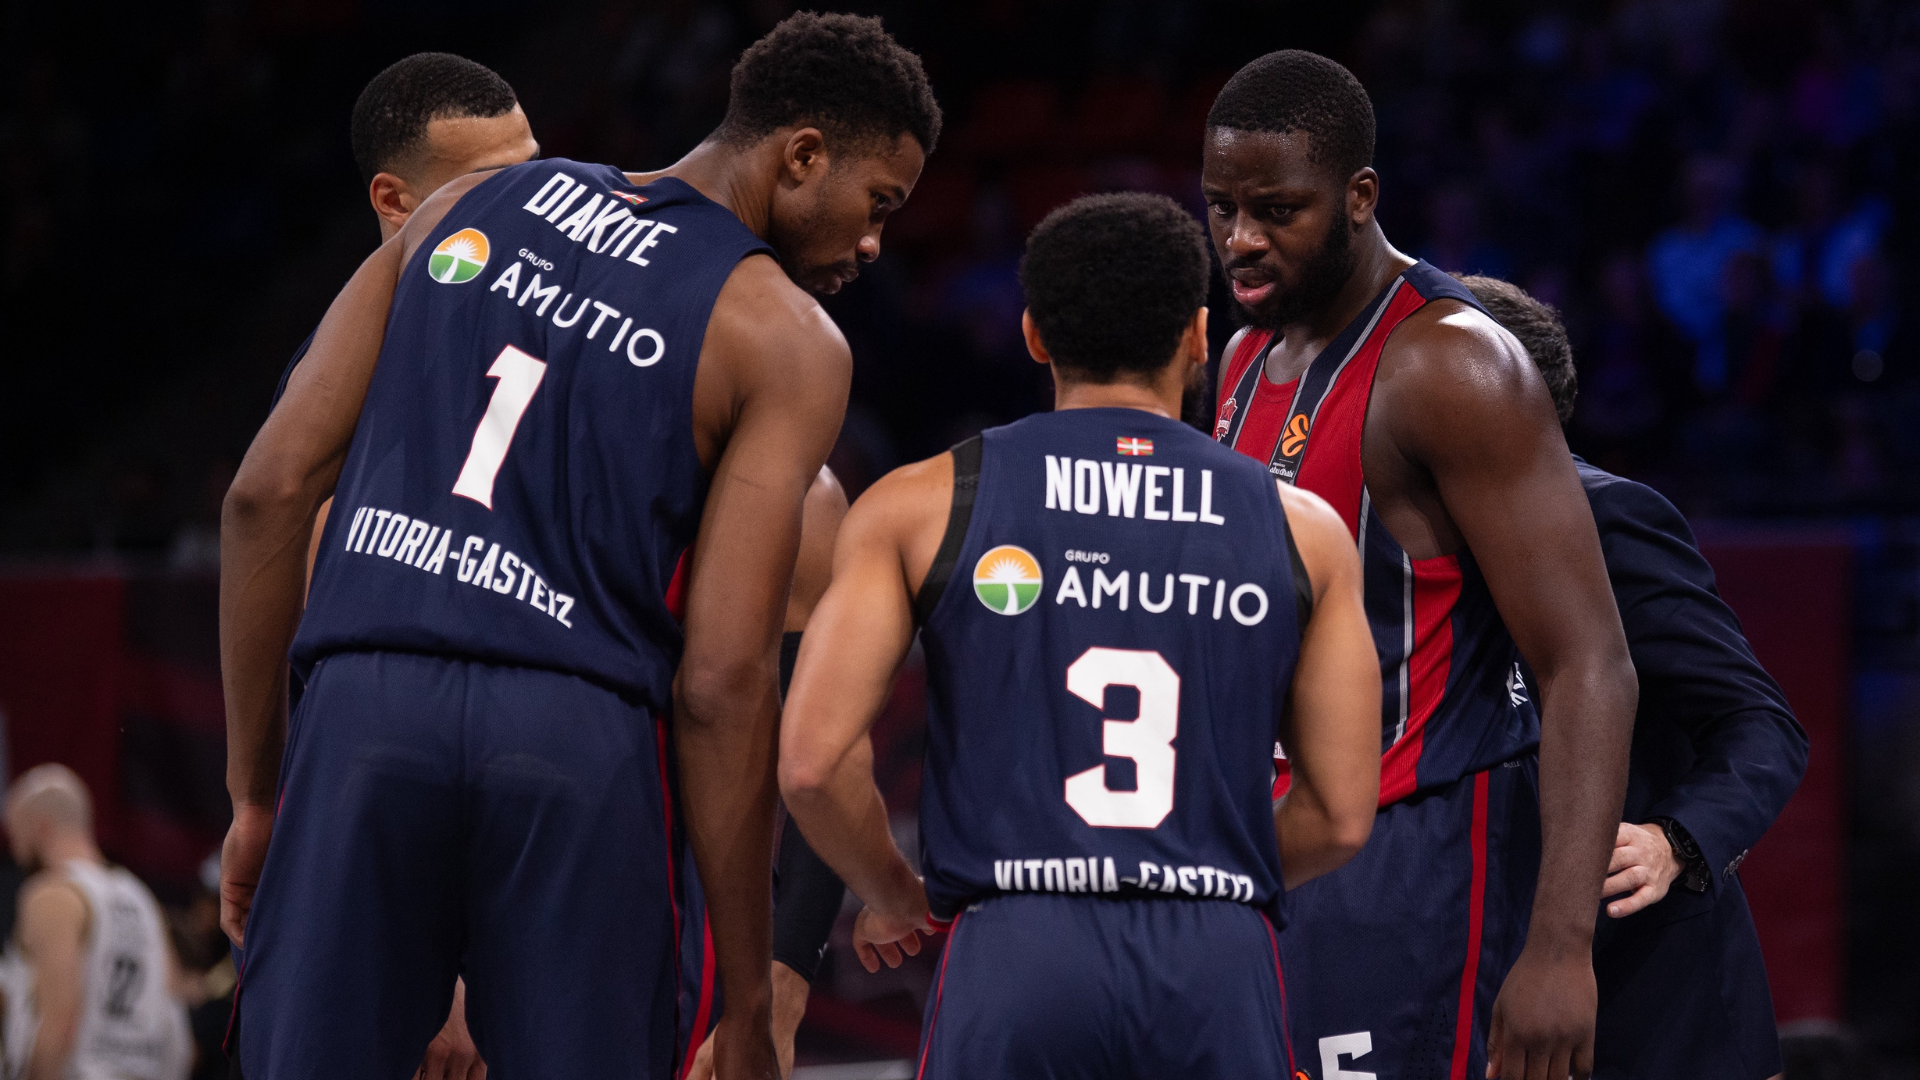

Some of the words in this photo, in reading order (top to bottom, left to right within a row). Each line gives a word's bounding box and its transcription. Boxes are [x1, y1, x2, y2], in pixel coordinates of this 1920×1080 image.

[518, 247, 555, 272] GRUPO
[522, 171, 679, 267] DIAKITE
[489, 261, 666, 368] AMUTIO
[451, 344, 547, 511] 1
[1044, 454, 1225, 526] NOWELL
[345, 506, 575, 630] VITORIA-GASTEIZ
[1055, 565, 1269, 626] AMUTIO
[1064, 549, 1110, 565] GRUPO
[1065, 646, 1181, 829] 3
